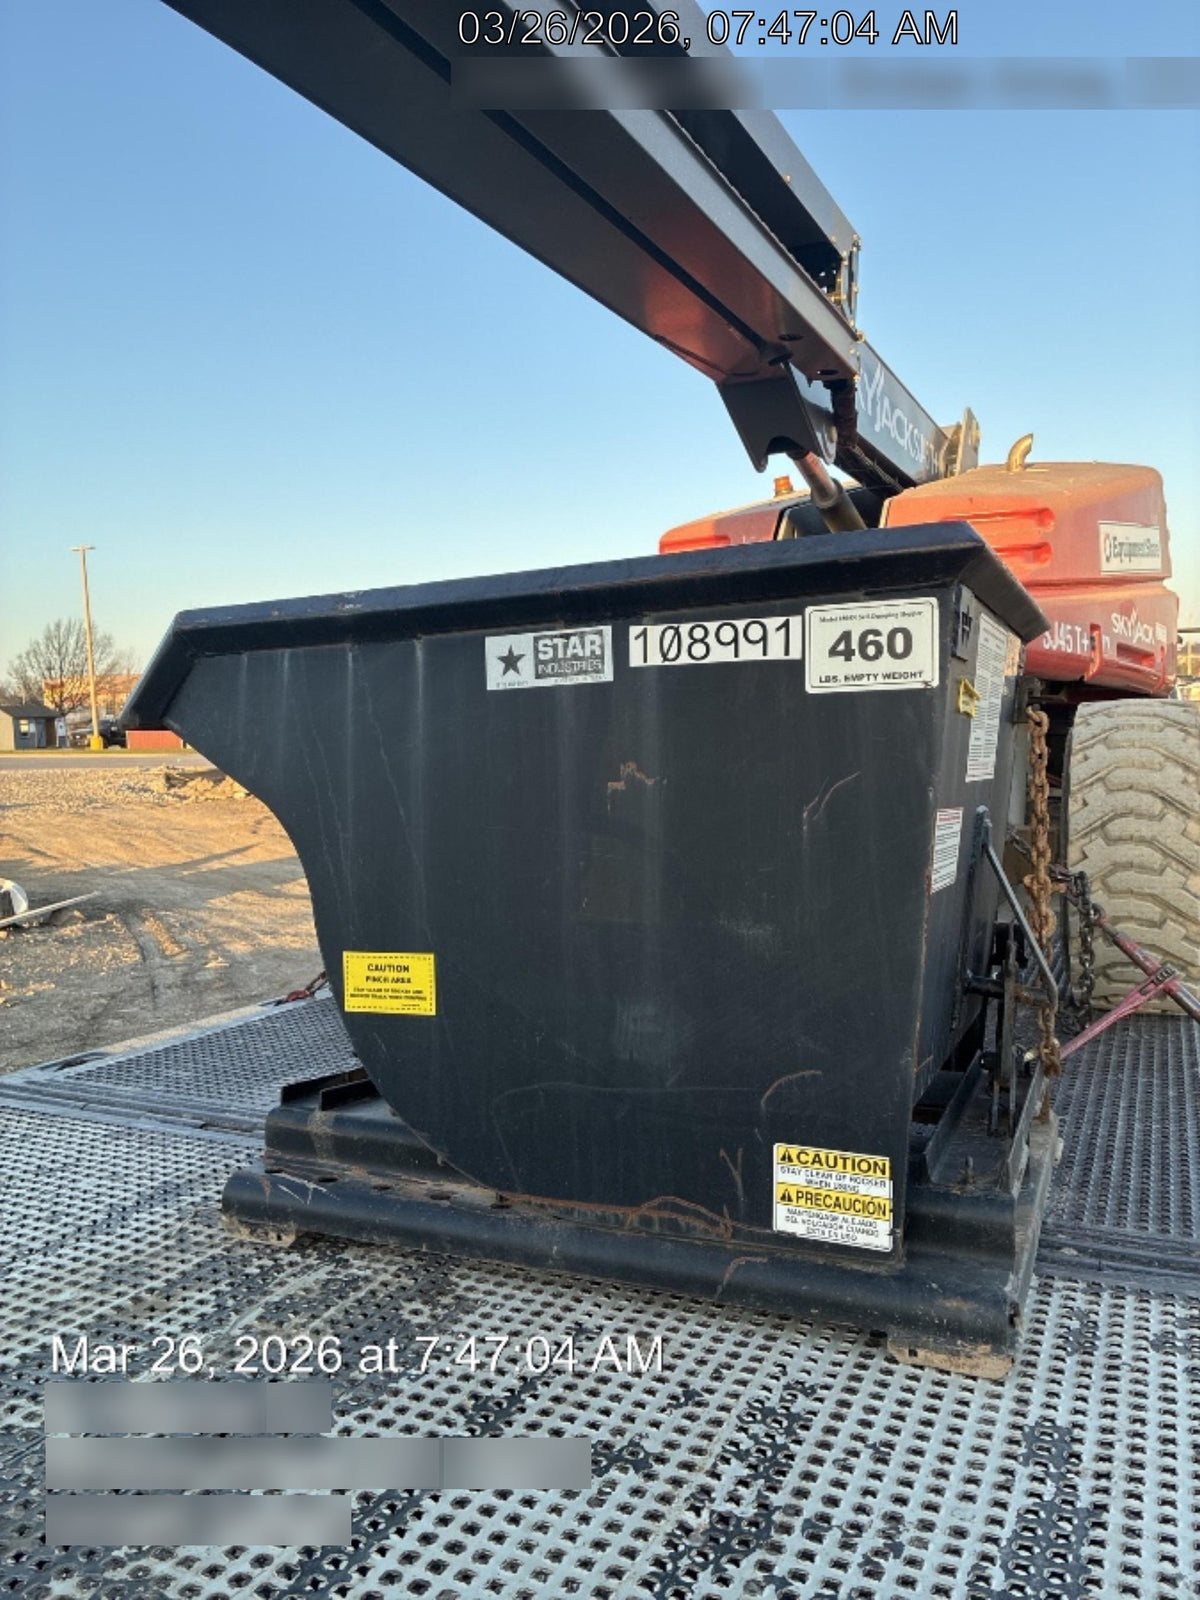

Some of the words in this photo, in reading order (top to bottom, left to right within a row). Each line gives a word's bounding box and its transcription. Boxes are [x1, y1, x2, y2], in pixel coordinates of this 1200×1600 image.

[1111, 607, 1155, 645] SKYJACK
[538, 633, 602, 661] STAR
[633, 618, 792, 664] 108991
[828, 627, 913, 662] 460
[538, 659, 602, 675] INDUSTRIES
[819, 674, 842, 684] LBS.
[844, 671, 879, 682] EMPTY
[881, 670, 924, 681] WEIGHT
[367, 963, 410, 974] CAUTION
[365, 975, 390, 984] PINCH
[780, 1166, 802, 1176] STAY
[805, 1169, 833, 1180] CLEAR
[835, 1172, 848, 1181] OF
[796, 1151, 887, 1176] CAUTION
[805, 1178, 831, 1188] WHEN
[796, 1190, 887, 1217] PRECAUCIÓN
